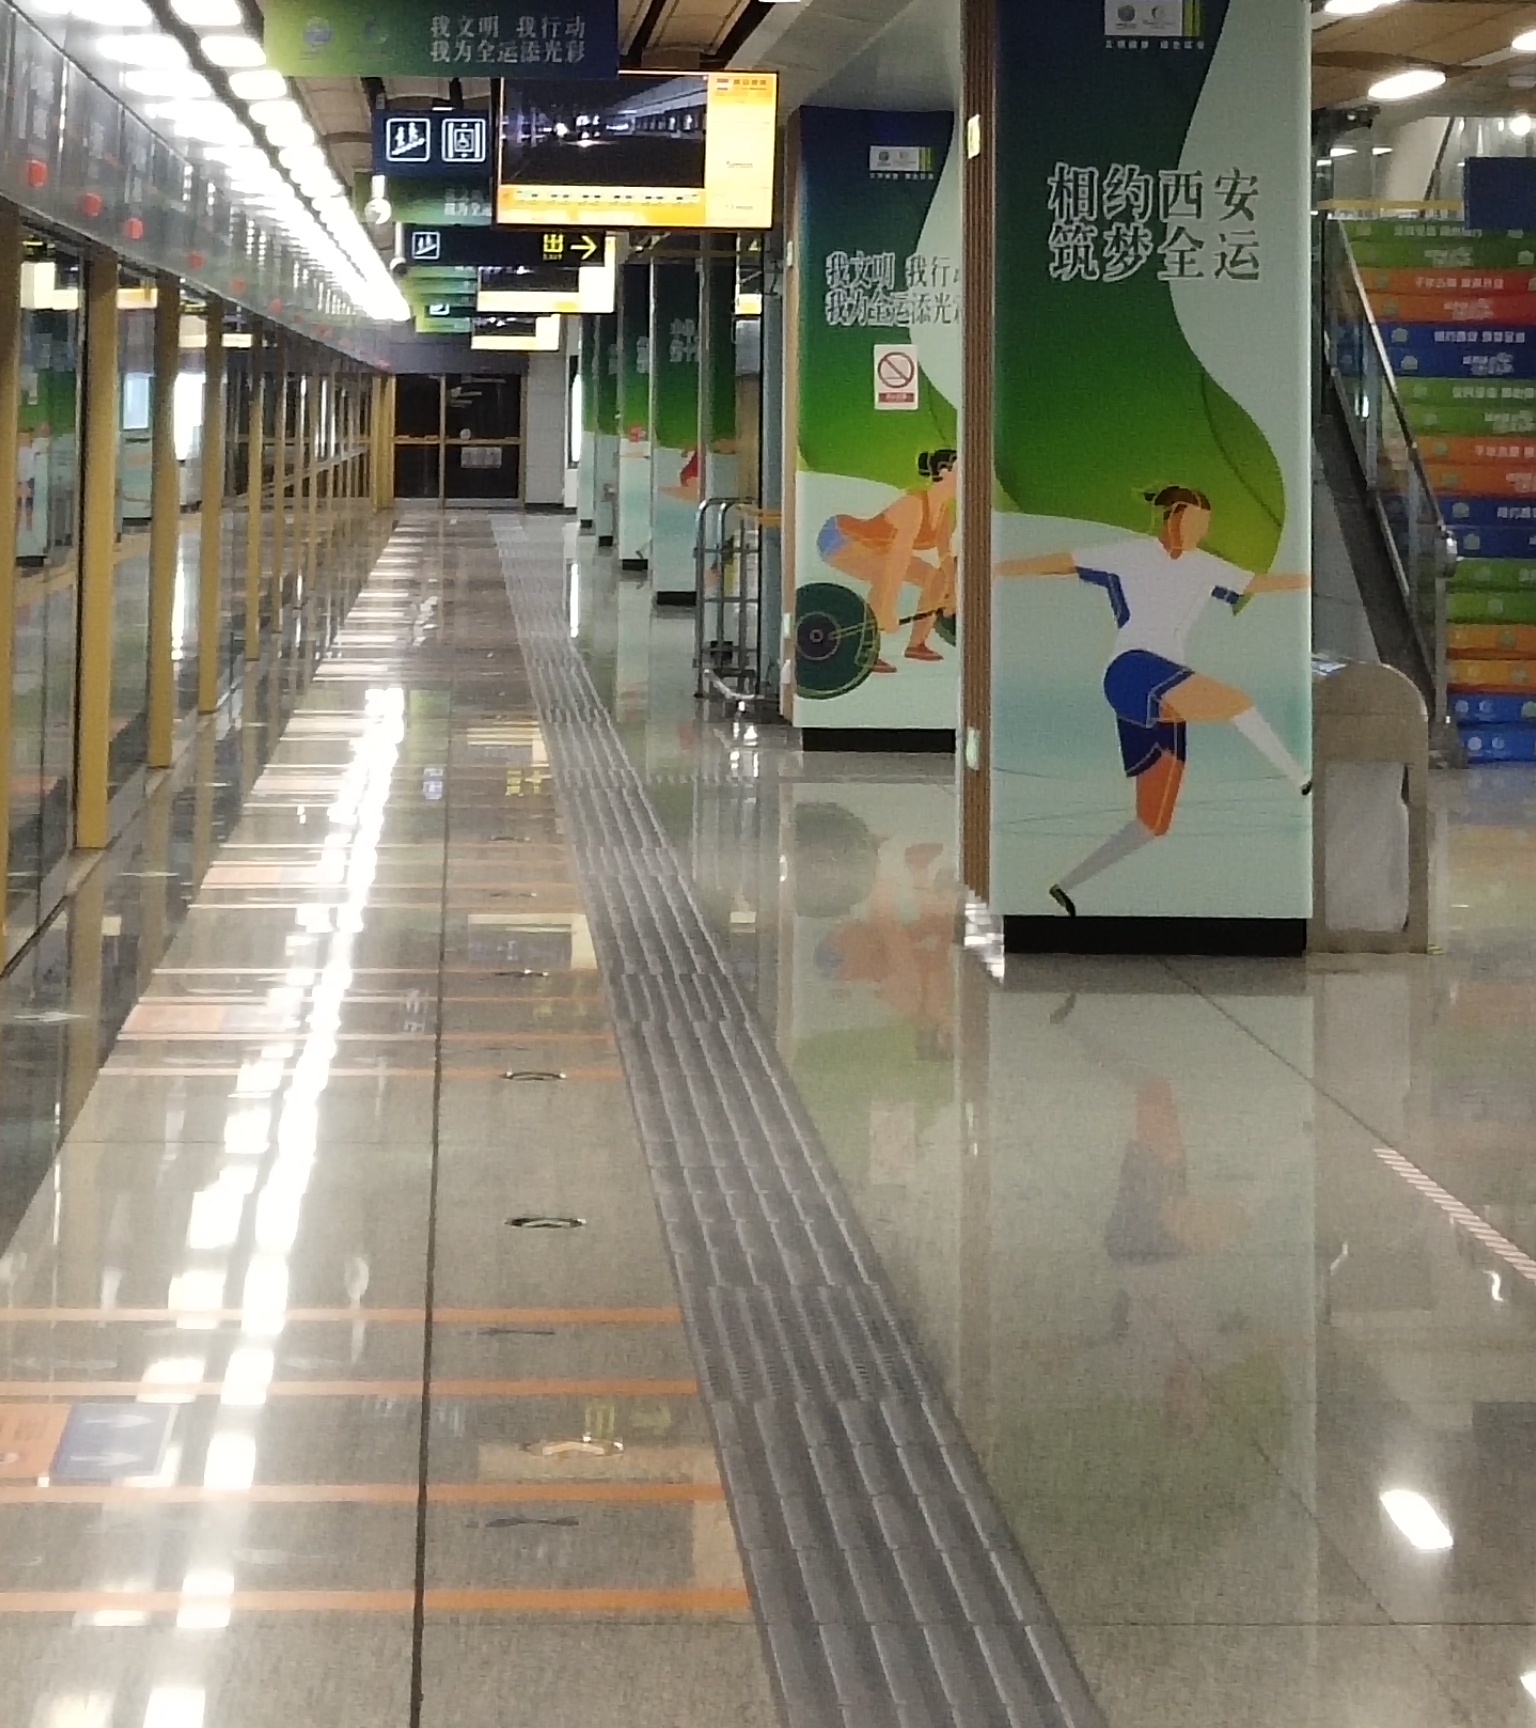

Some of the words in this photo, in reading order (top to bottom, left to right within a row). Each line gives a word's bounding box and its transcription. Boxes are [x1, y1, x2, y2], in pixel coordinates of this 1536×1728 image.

[430, 15, 499, 39] 我文明
[516, 15, 586, 39] 我行动
[1047, 162, 1260, 223] 相约西安
[543, 233, 564, 254] 出
[1048, 222, 1260, 283] 筑梦全运
[825, 250, 896, 290] 我文明
[905, 253, 962, 289] 我行
